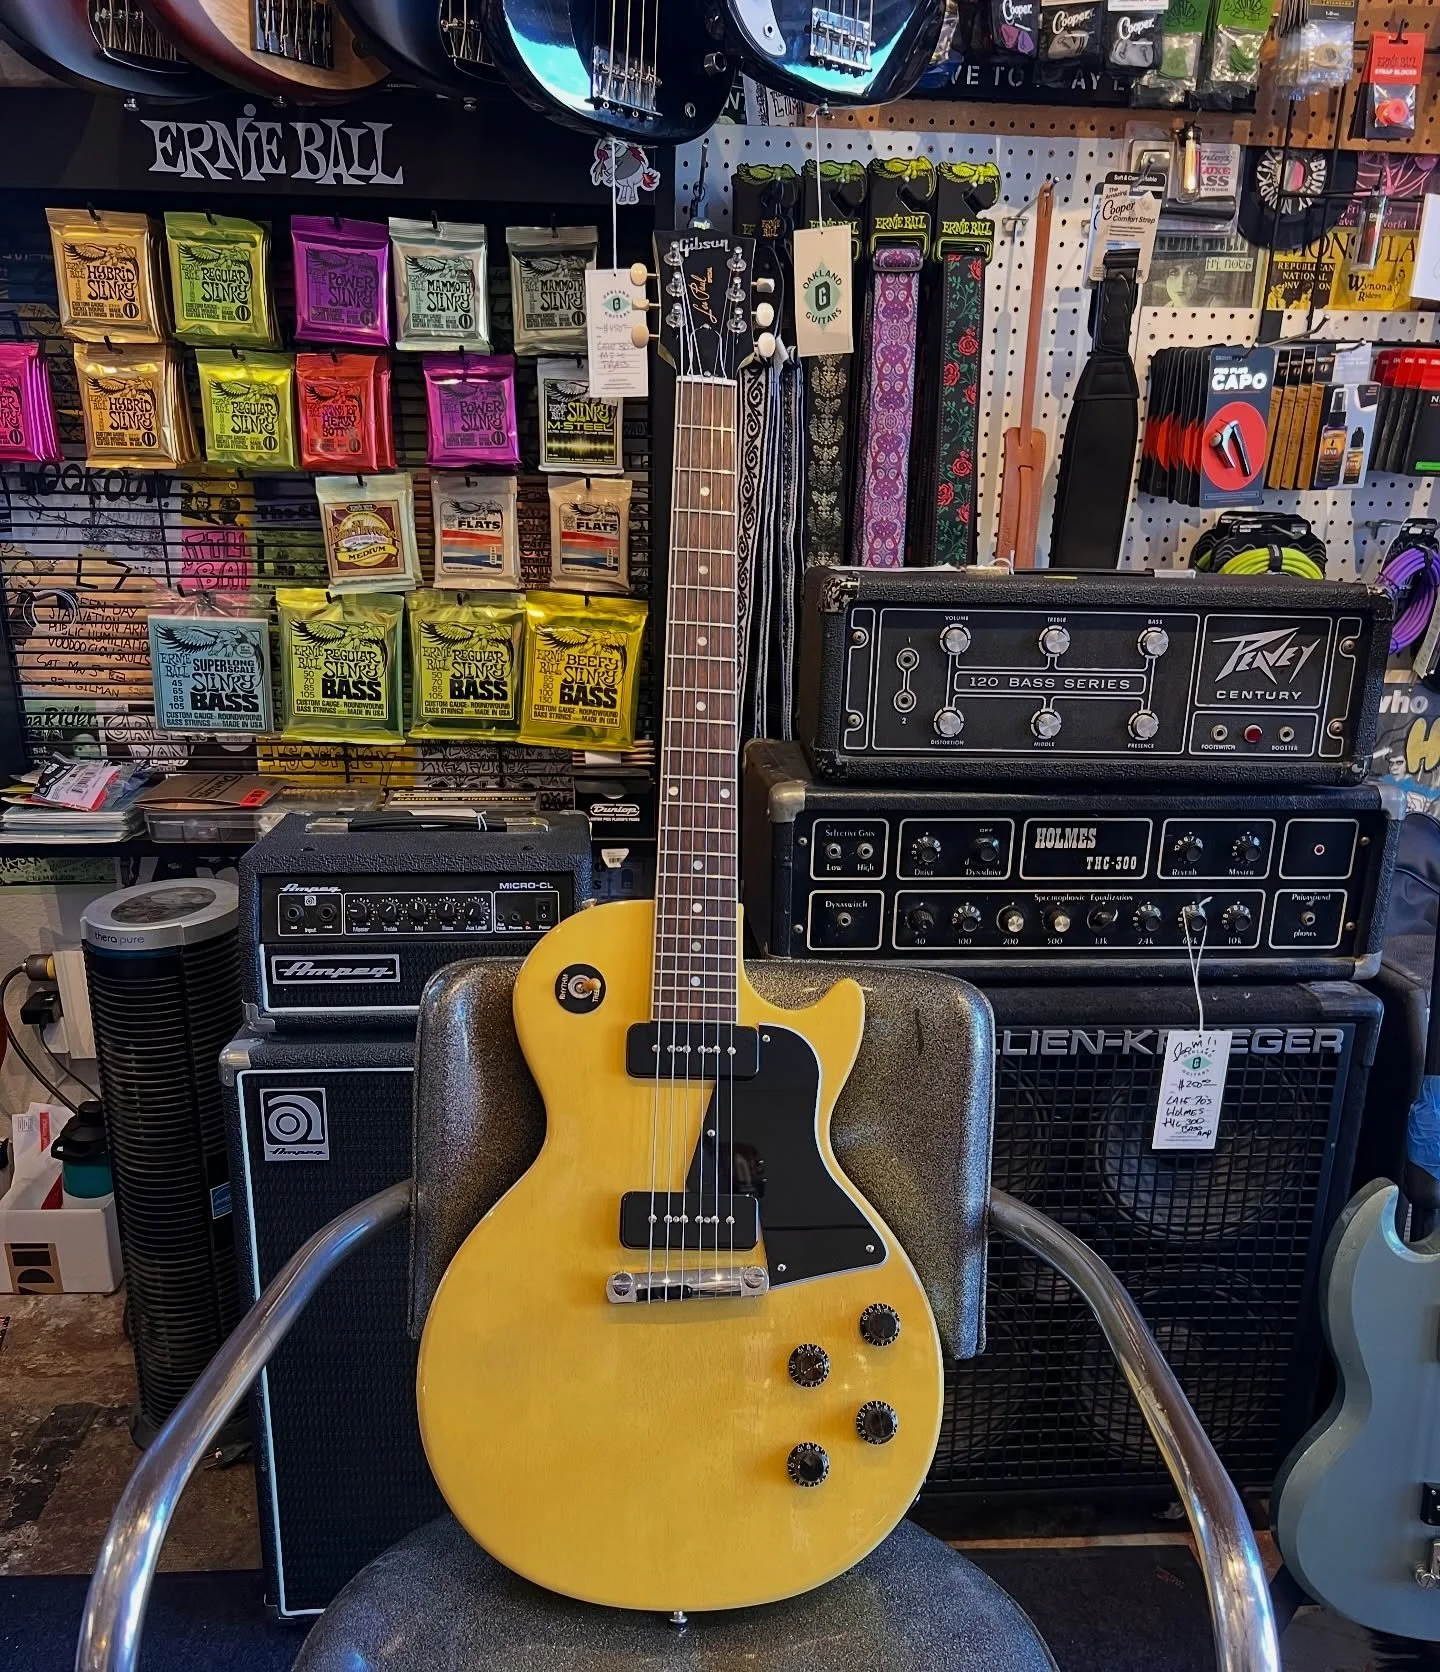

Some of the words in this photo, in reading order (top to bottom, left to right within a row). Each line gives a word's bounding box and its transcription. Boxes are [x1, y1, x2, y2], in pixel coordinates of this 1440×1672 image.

[139, 104, 286, 181] ERNIE
[289, 119, 403, 185] BALL
[1102, 200, 1136, 221] Cooper
[875, 213, 903, 229] ERNIE
[903, 216, 926, 229] BALL
[942, 217, 970, 235] ERNIE
[970, 221, 992, 236] BALL
[1112, 215, 1137, 223] Comfort
[679, 236, 731, 258] Gibson
[86, 265, 135, 284] HYBRID
[201, 268, 247, 287] REGULAR
[328, 272, 371, 290] POWER
[803, 270, 843, 290] OAKLAND
[426, 279, 472, 294] MAMMOTH
[540, 279, 584, 292] MAMMOTH
[1348, 273, 1393, 293] Wynona
[87, 280, 136, 303] SLINKY
[201, 282, 249, 305] SLINKY
[328, 286, 374, 310] SLINKY
[426, 291, 472, 314] SLINKY
[540, 291, 584, 312] SLINKY
[805, 306, 842, 322] GUITARS
[1211, 372, 1268, 391] CAPO
[108, 397, 152, 412] HYBRID
[231, 400, 274, 417] REGULAR
[460, 400, 504, 415] POWER
[567, 402, 609, 423] SLINKY
[109, 411, 152, 432] SLINKY
[230, 415, 276, 436] SLINKY
[322, 415, 357, 428] HEAVY
[460, 413, 503, 433] SLINKY
[457, 520, 501, 530] FLATS
[576, 521, 618, 532] FLATS
[348, 546, 386, 561] MEDIUM
[944, 614, 969, 622] VOLUME
[1046, 616, 1067, 624] TREBLE
[292, 645, 324, 658] ERNIE
[323, 648, 380, 665] REGULAR
[422, 647, 452, 660] ERNIE
[451, 649, 507, 665] REGULAR
[536, 649, 565, 665] ERNIE
[1212, 627, 1321, 685] PEAVEY
[159, 652, 192, 667] ERNIE
[193, 658, 227, 674] SUPER
[227, 659, 255, 667] LONG
[297, 657, 322, 671] BALL
[426, 658, 450, 672] BALL
[566, 655, 620, 673] BEEFY
[165, 665, 190, 679] BALL
[227, 666, 255, 675] SCALE
[322, 661, 379, 682] SLINKY
[450, 662, 505, 682] SLINKY
[539, 662, 562, 677] BALL
[191, 673, 256, 695] SLINKY
[562, 666, 618, 690] SLINKY
[969, 676, 998, 687] 120
[1009, 677, 1060, 689] BASS
[1063, 679, 1131, 690] SERIES
[74, 685, 120, 699] GILMAN
[321, 678, 381, 702] BASS
[449, 678, 508, 702] BASS
[559, 682, 618, 710] BASS
[1216, 690, 1302, 700] CENTURY
[189, 692, 259, 712] BASS
[296, 699, 321, 707] CUSTOM
[321, 700, 340, 708] GAUGE
[343, 702, 384, 711] ROUNDWOUND
[166, 711, 193, 720] CUSTOM
[193, 712, 214, 720] GAUGE
[217, 713, 263, 723] ROUNDWOUND
[296, 705, 312, 713] BASS
[312, 706, 337, 715] STRINGS
[347, 708, 364, 717] MADE
[365, 709, 371, 717] IN
[372, 710, 385, 718] USA
[184, 719, 210, 728] STRINGS
[222, 720, 241, 729] MADE
[241, 721, 248, 729] IN
[249, 722, 263, 730] USA
[930, 739, 965, 747] DISTORTION
[1271, 744, 1298, 752] BOOSTER
[593, 805, 638, 815] Dunlop
[858, 829, 875, 837] Gain
[1034, 827, 1097, 849] HOLMES
[826, 863, 842, 871] Low
[857, 863, 874, 873] High
[1086, 856, 1137, 871] THC-300
[914, 868, 934, 877] Drive
[279, 883, 342, 893] Ampeg
[499, 882, 554, 890] MICRO-CL
[825, 901, 868, 909] Dynaswitch
[1090, 893, 1134, 902] Equalization
[352, 926, 370, 934] Master
[1293, 929, 1317, 939] phones
[1228, 937, 1242, 945] 10k
[278, 961, 394, 979] Ampeg
[559, 974, 570, 1001] RHYTHM
[1187, 1117, 1205, 1126] 300
[269, 1147, 325, 1156] Ampeg
